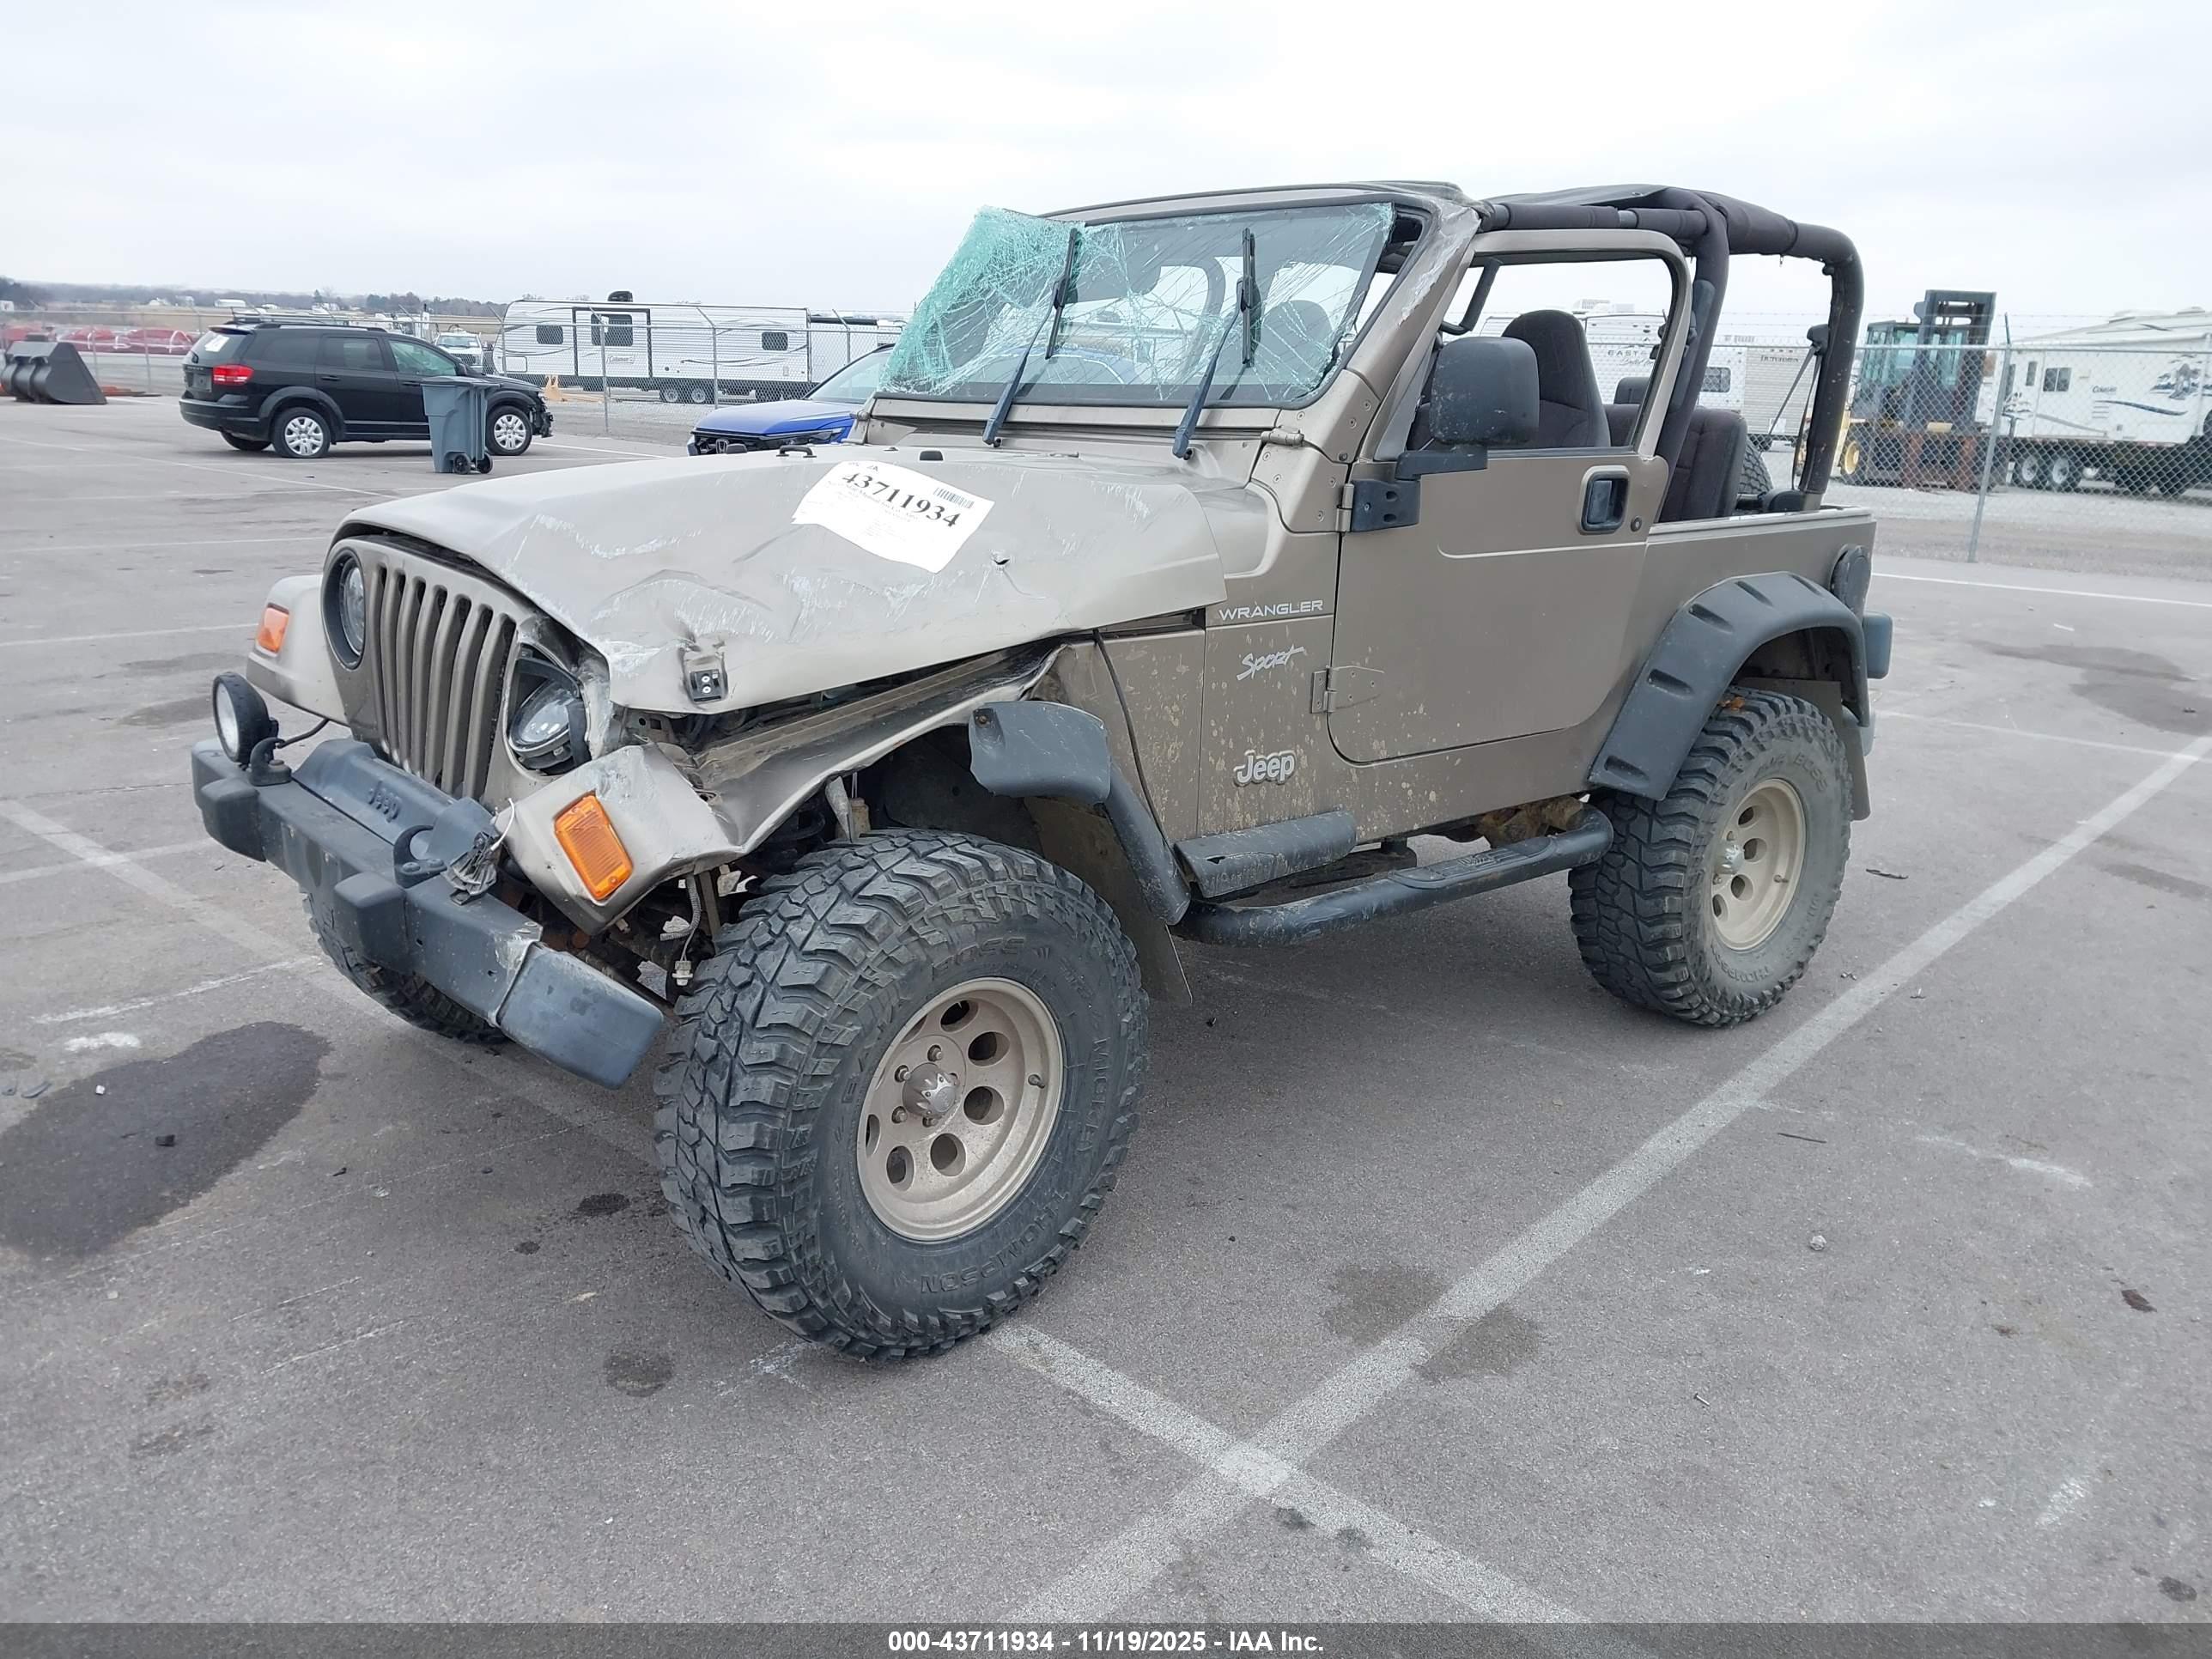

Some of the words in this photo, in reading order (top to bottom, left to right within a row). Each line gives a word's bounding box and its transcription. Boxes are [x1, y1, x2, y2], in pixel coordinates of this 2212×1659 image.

[842, 473, 961, 527] 43711934
[1219, 600, 1323, 620] WRANGLER
[1237, 754, 1295, 784] Jeep
